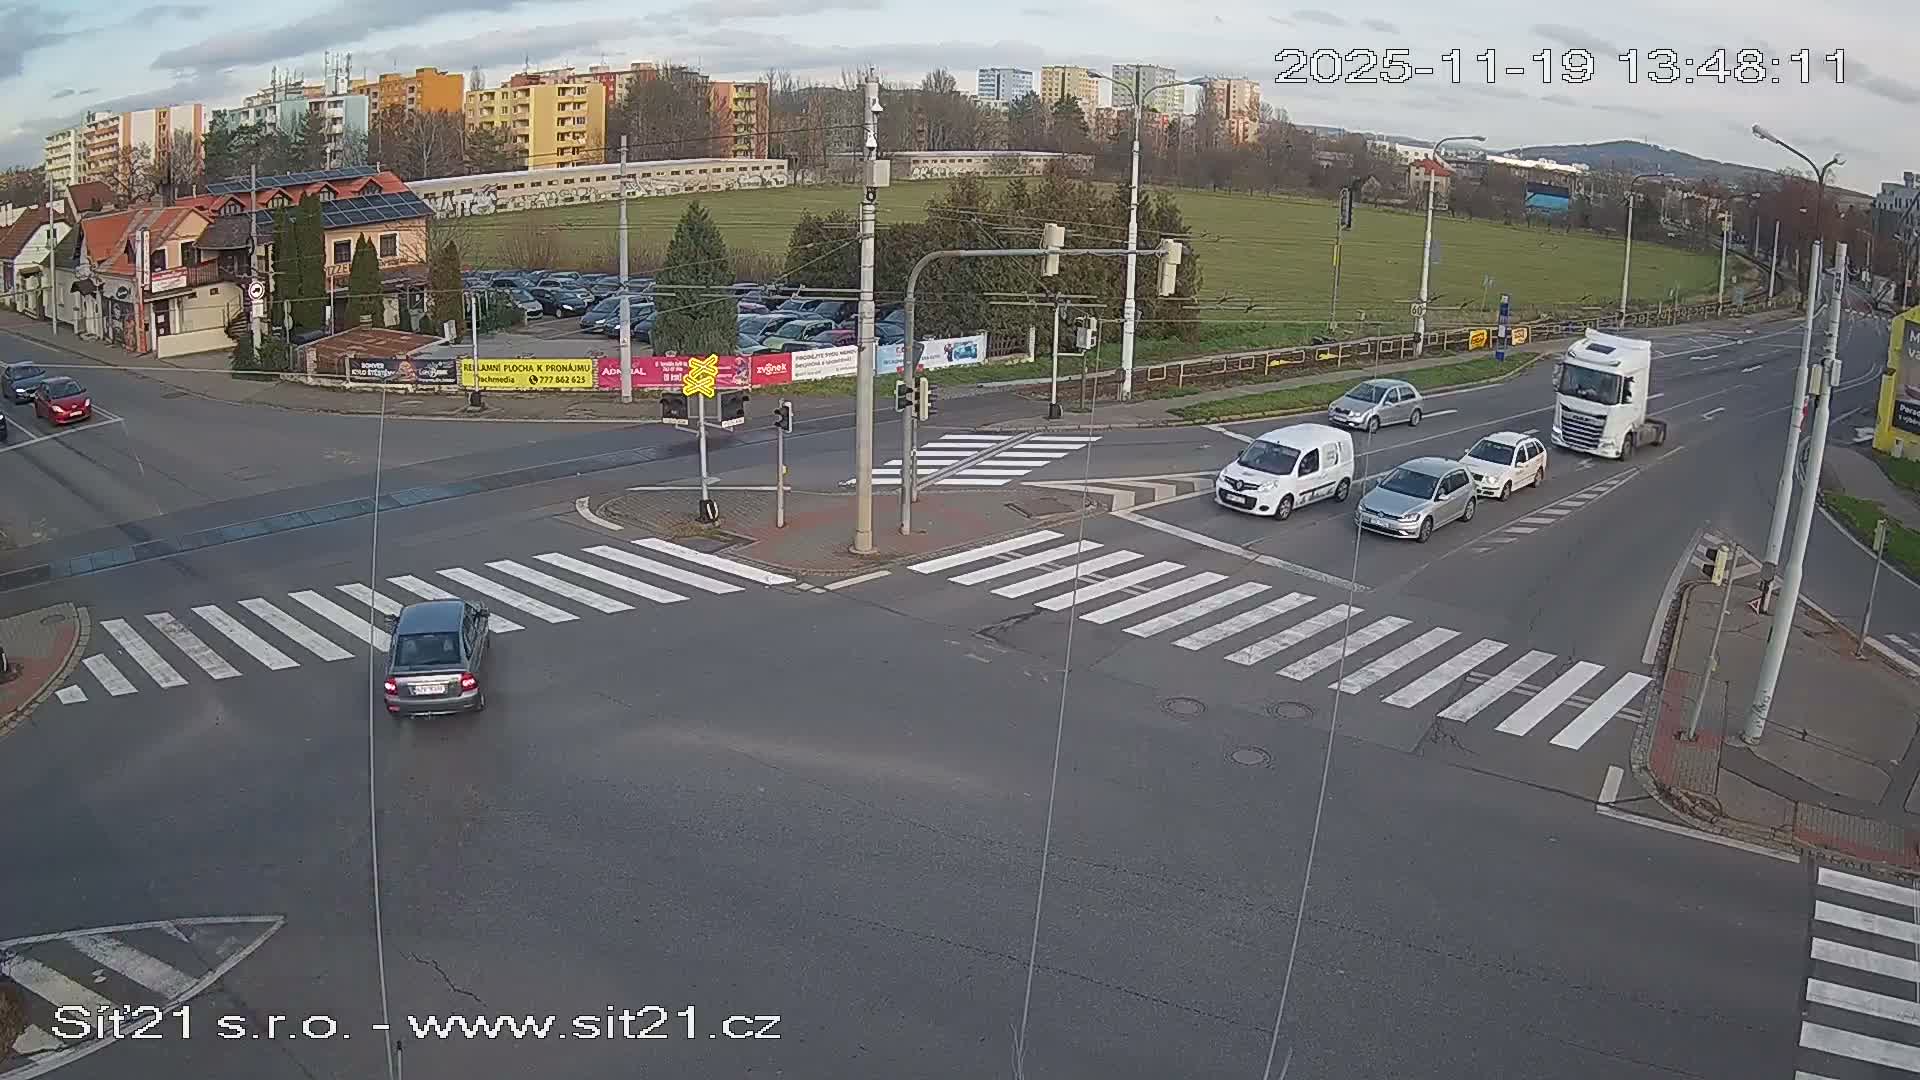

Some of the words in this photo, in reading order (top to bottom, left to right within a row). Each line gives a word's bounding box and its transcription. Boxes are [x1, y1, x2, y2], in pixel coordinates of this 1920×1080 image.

[504, 363, 534, 373] PLOCHA
[537, 363, 543, 371] K
[546, 361, 590, 372] PRONÁJMU
[601, 367, 647, 377] ADMRAL
